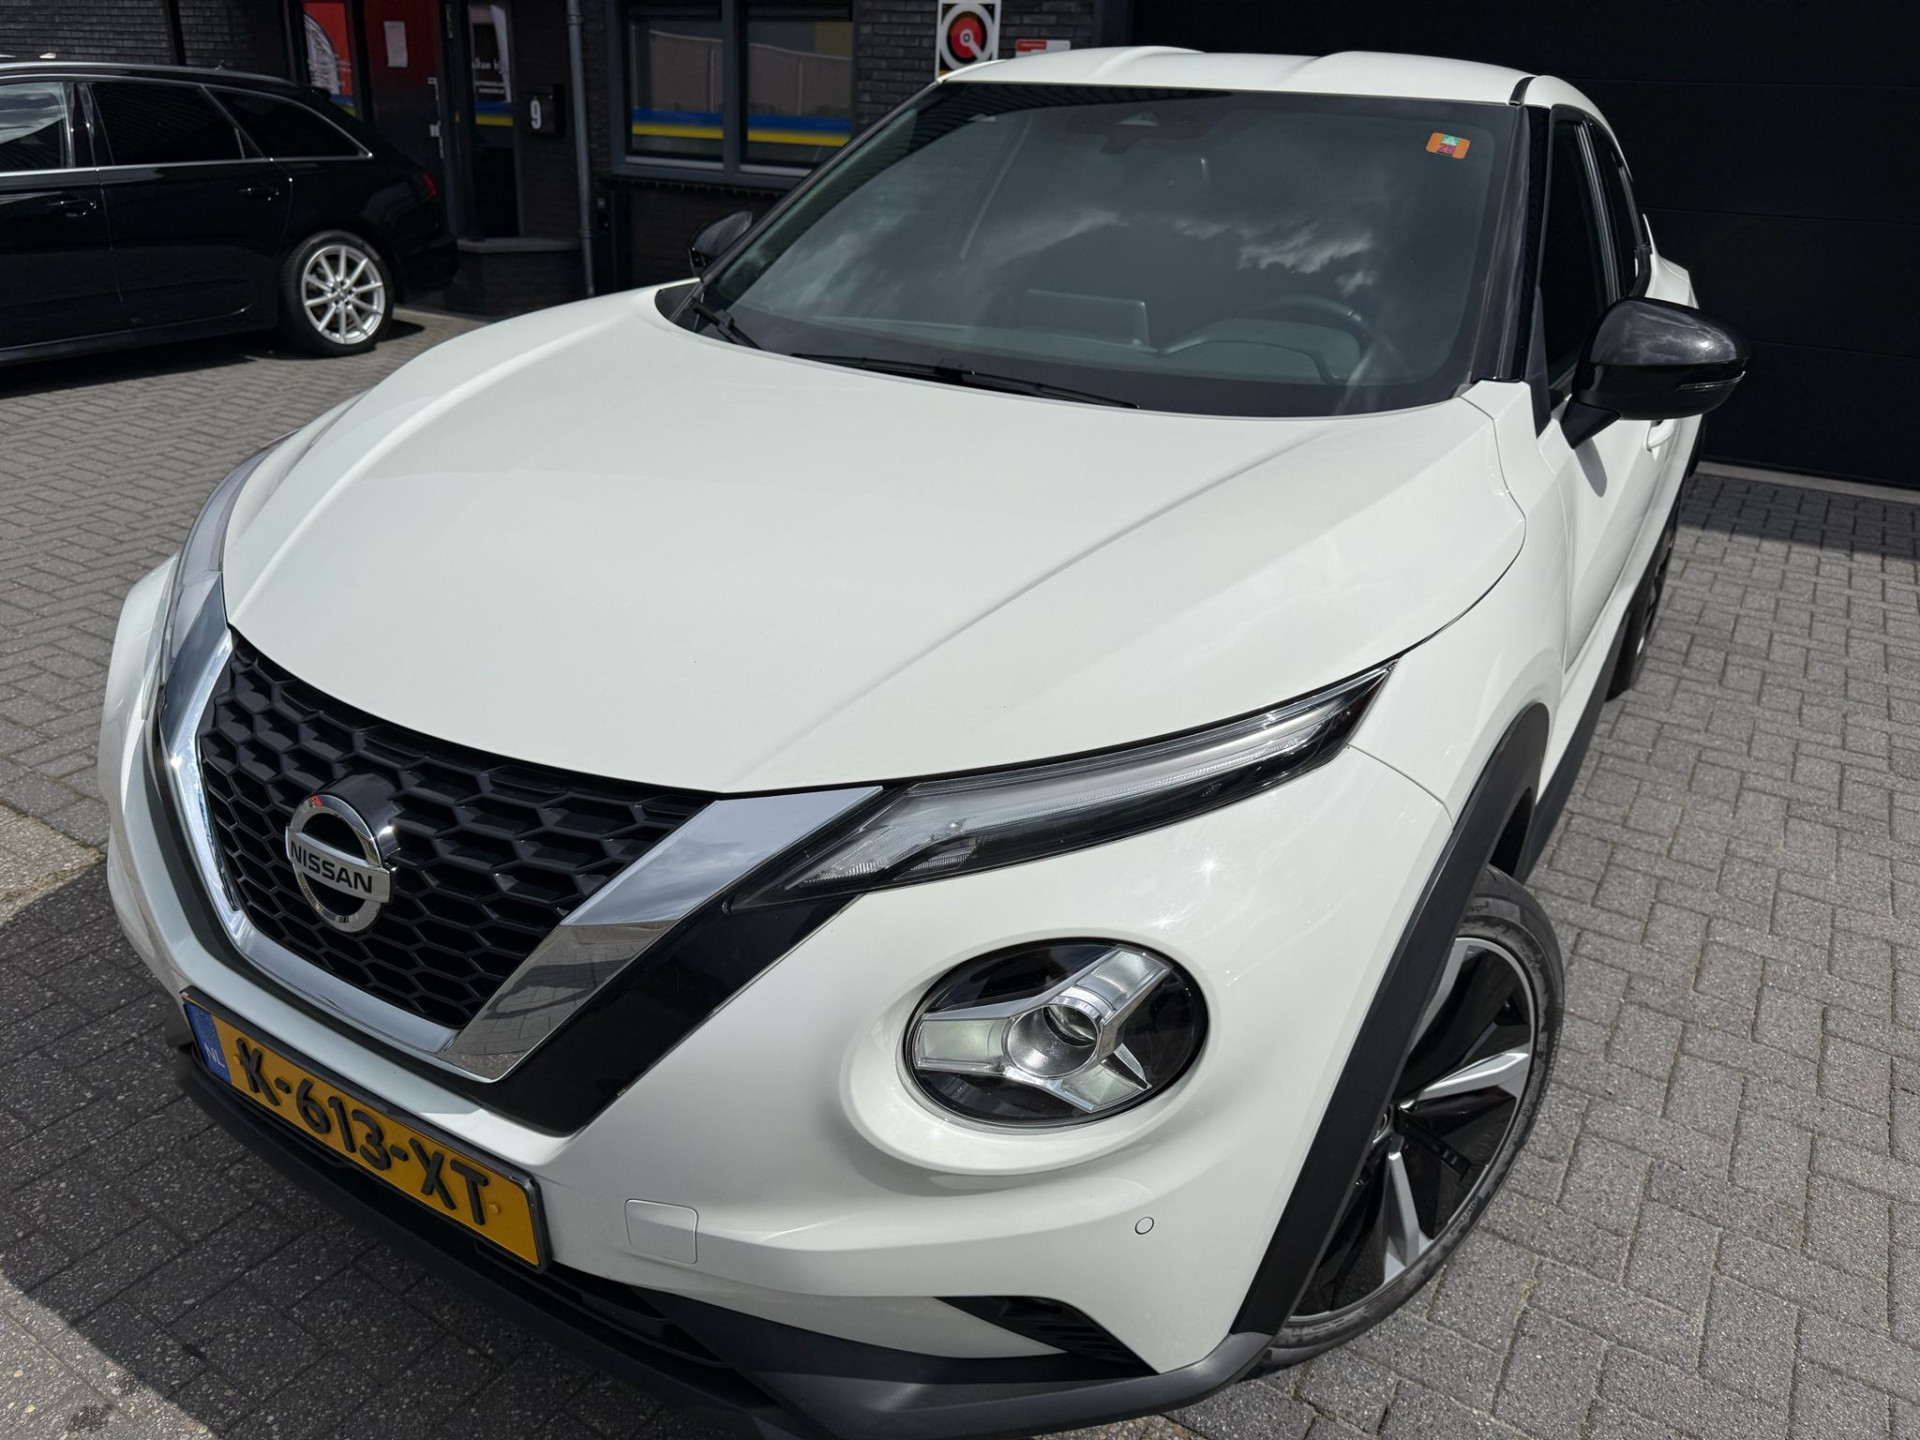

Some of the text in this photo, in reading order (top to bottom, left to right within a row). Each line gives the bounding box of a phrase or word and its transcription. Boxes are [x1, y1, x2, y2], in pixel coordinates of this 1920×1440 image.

[531, 100, 542, 129] 9
[291, 840, 372, 894] NISSAN
[203, 1042, 225, 1068] NL
[236, 1037, 489, 1226] K-613-XT
